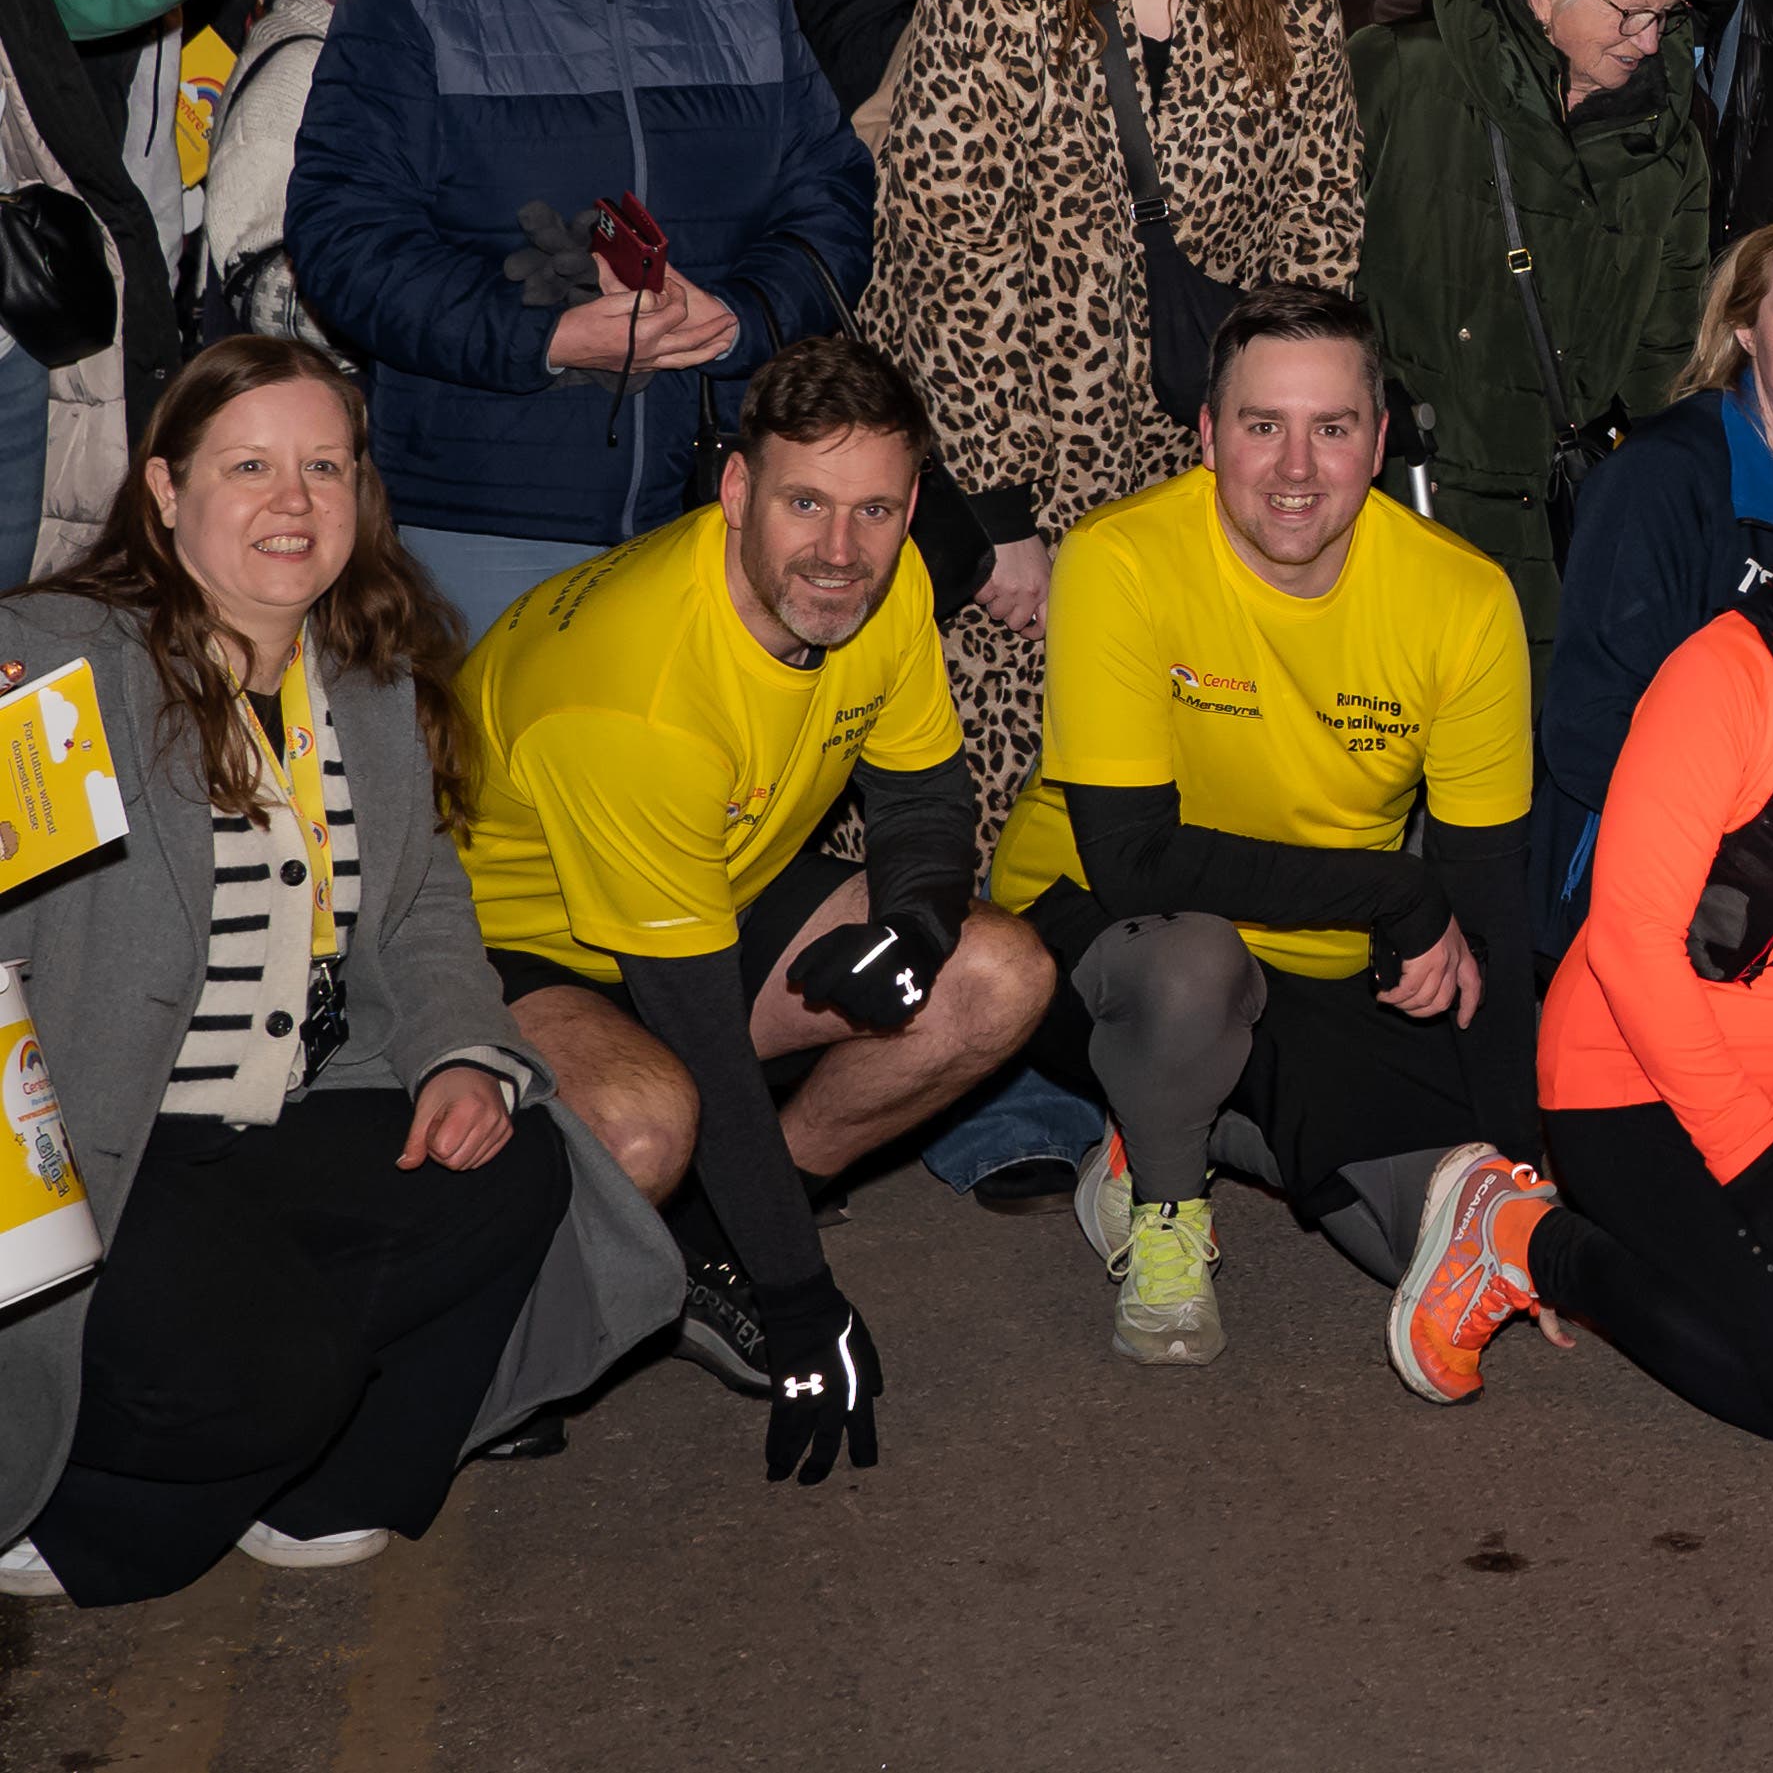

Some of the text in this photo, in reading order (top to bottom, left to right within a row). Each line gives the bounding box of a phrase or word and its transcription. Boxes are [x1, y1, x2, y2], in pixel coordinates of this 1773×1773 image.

[1203, 672, 1250, 693] Centre
[1336, 692, 1402, 717] Running
[11, 740, 40, 831] domestic abuse
[23, 720, 34, 738] For
[30, 750, 44, 788] future
[39, 788, 58, 836] without
[1454, 1172, 1497, 1242] SCARPA
